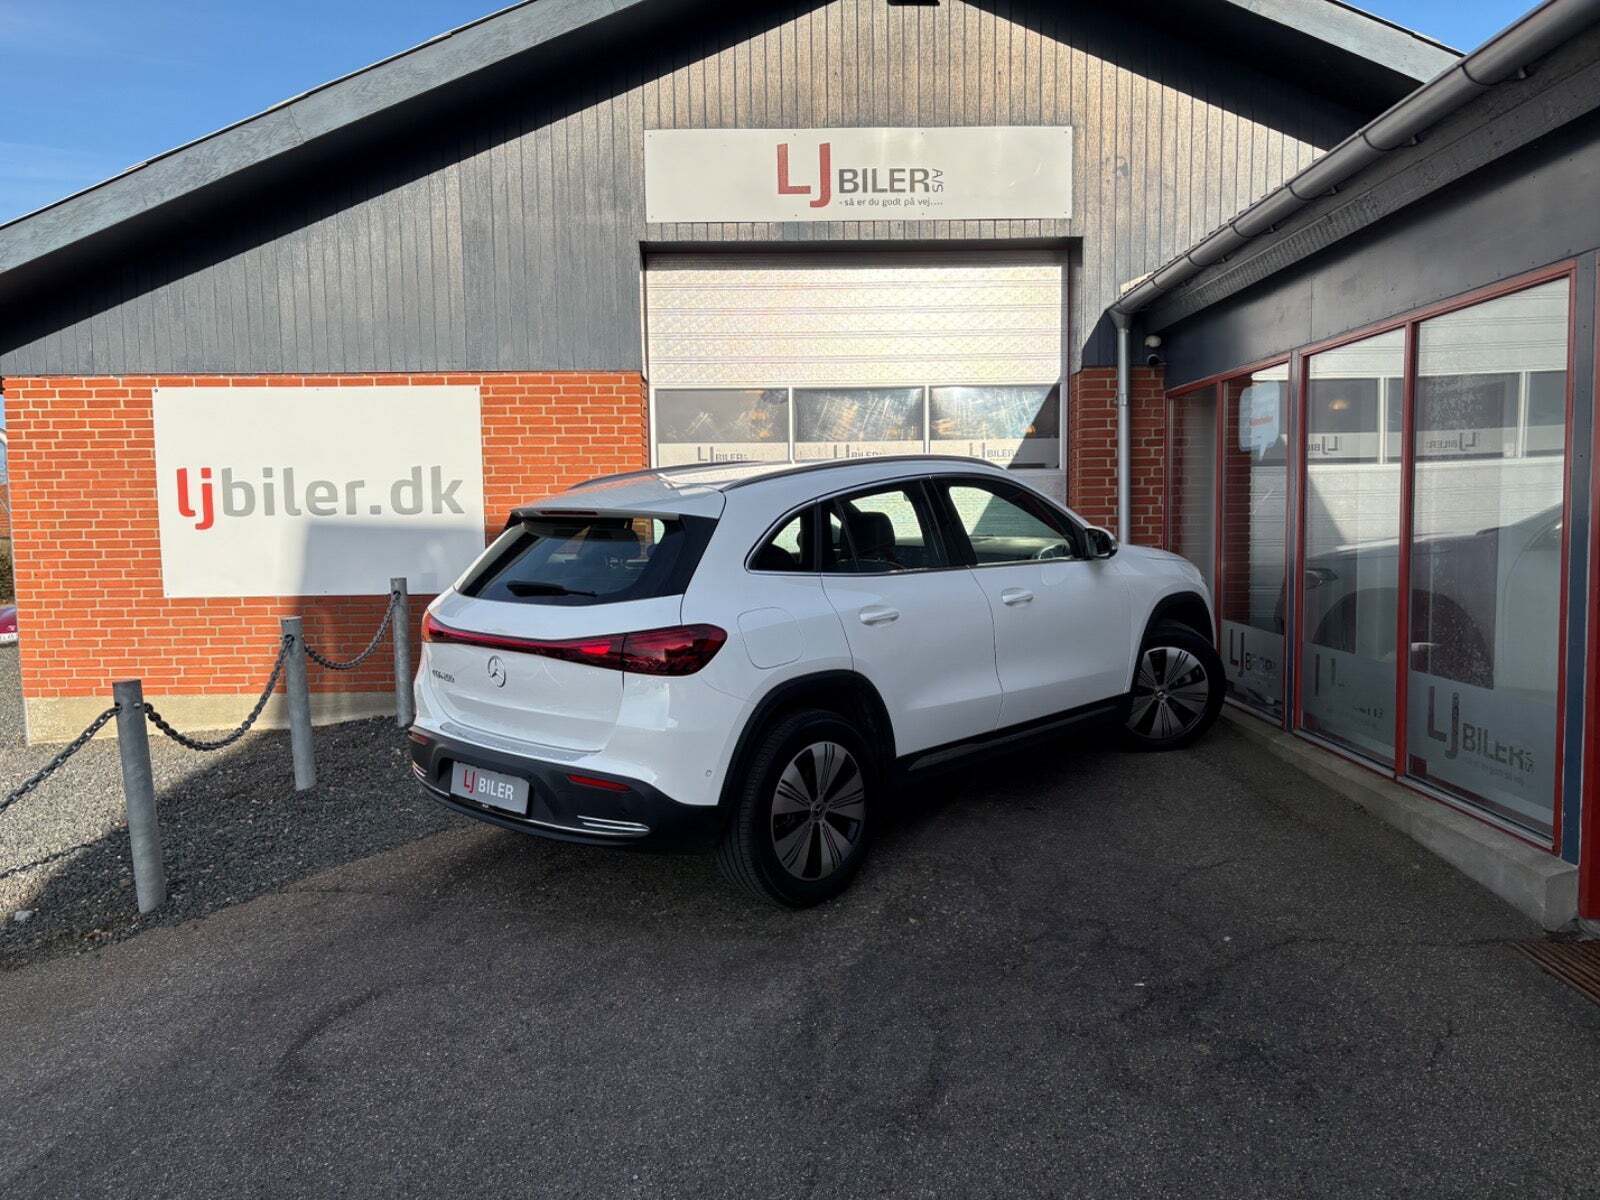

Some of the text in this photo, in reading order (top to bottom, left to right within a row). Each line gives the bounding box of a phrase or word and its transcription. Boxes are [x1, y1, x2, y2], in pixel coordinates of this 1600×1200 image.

[777, 142, 944, 208] LJ BILER A/S
[868, 198, 880, 206] du
[882, 198, 901, 208] godt
[904, 197, 915, 208] på
[176, 465, 465, 530] ljbiler.dk
[464, 769, 514, 800] LJ BILER
